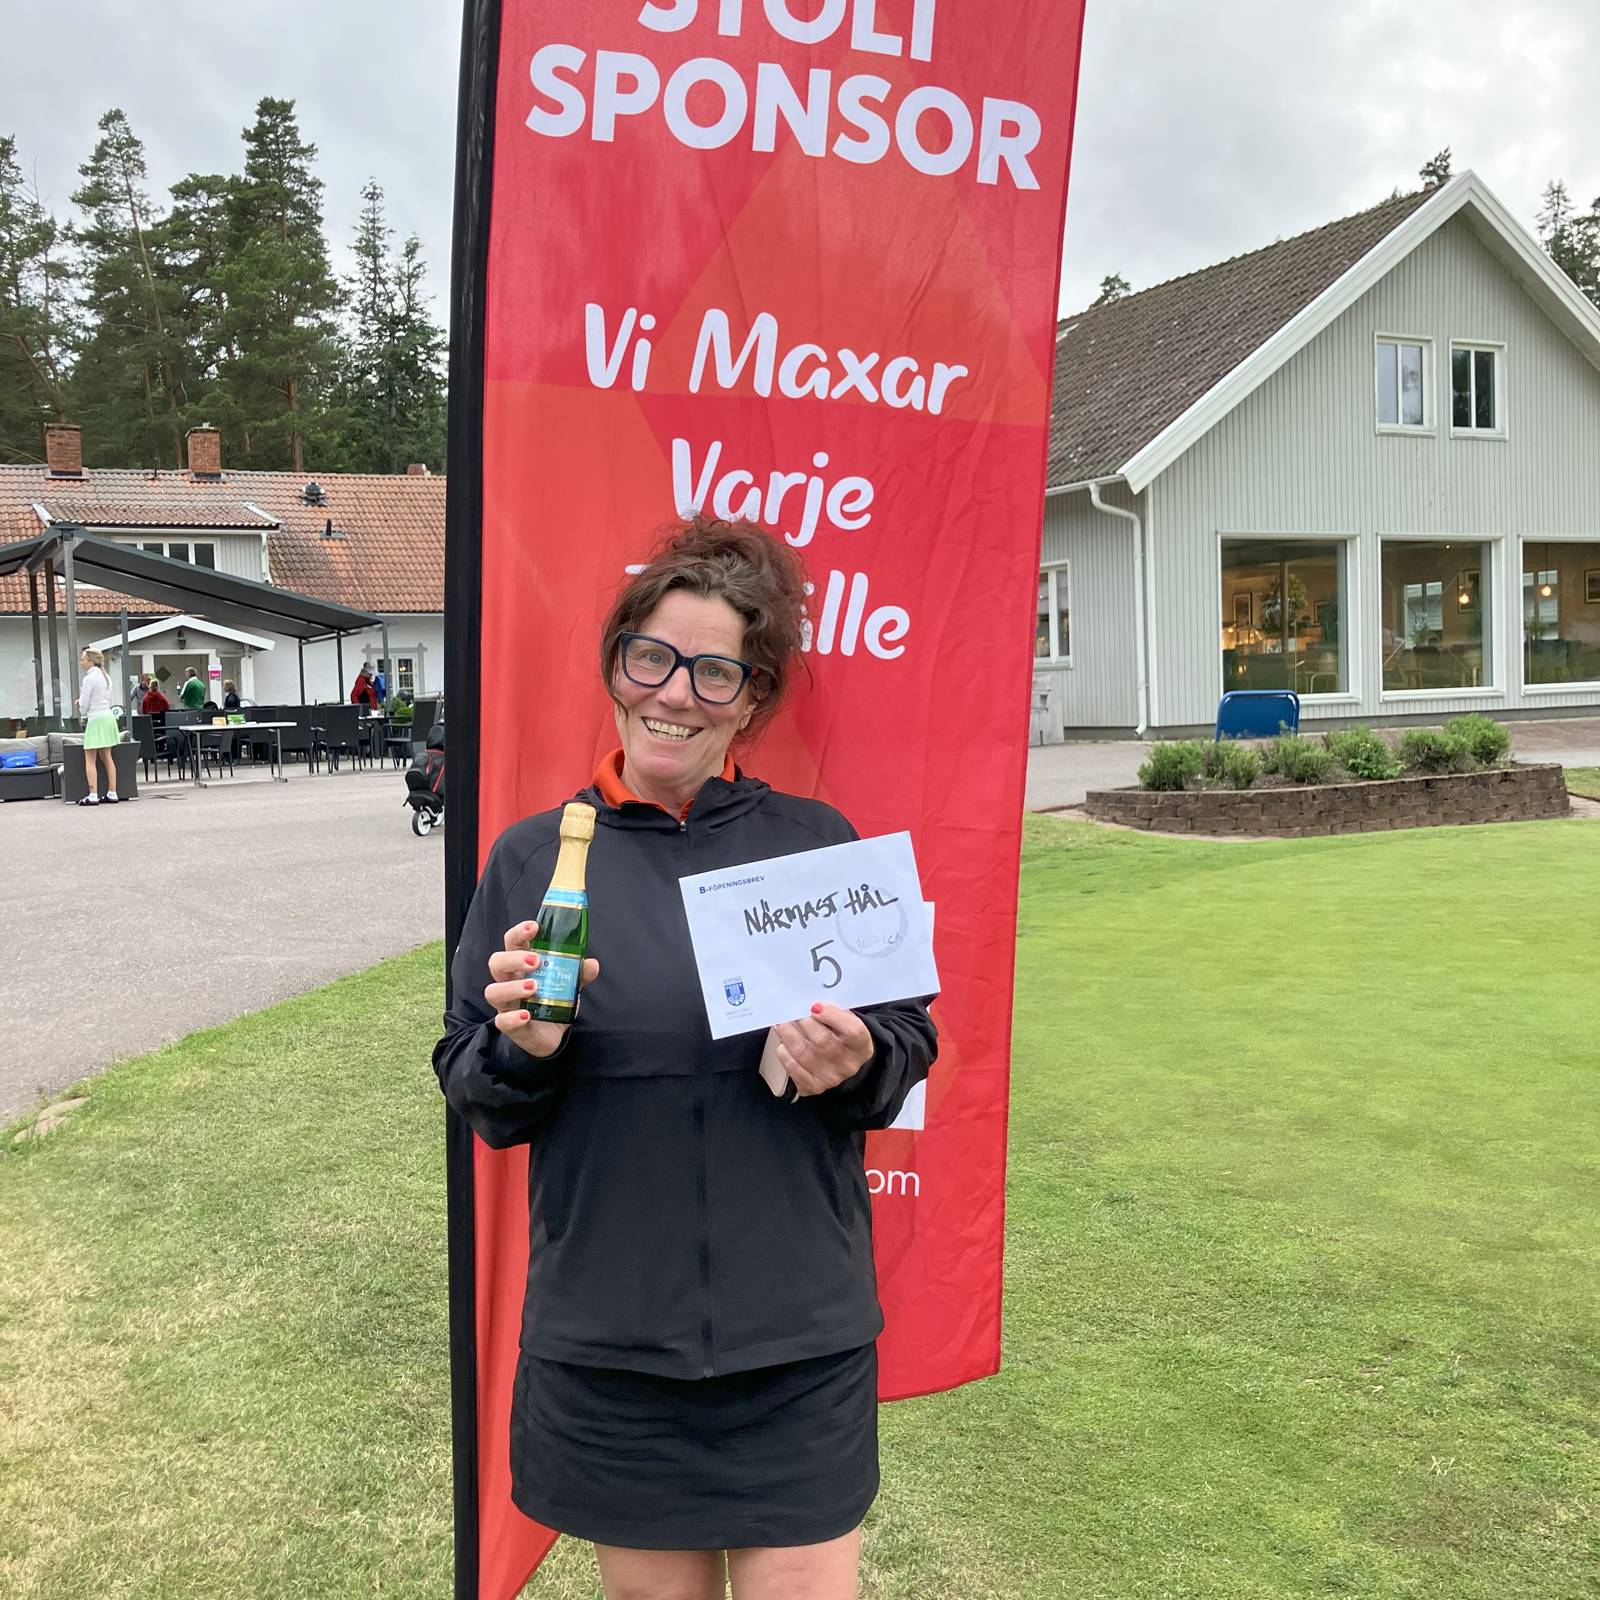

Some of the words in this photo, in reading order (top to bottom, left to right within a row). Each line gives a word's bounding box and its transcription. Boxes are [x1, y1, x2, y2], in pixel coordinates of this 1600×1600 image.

[525, 43, 1042, 190] SPONSOR
[585, 303, 655, 391] Vi
[689, 308, 968, 416] Maxar
[672, 438, 874, 547] Varje
[844, 883, 899, 916] HÅL
[810, 939, 843, 989] 5
